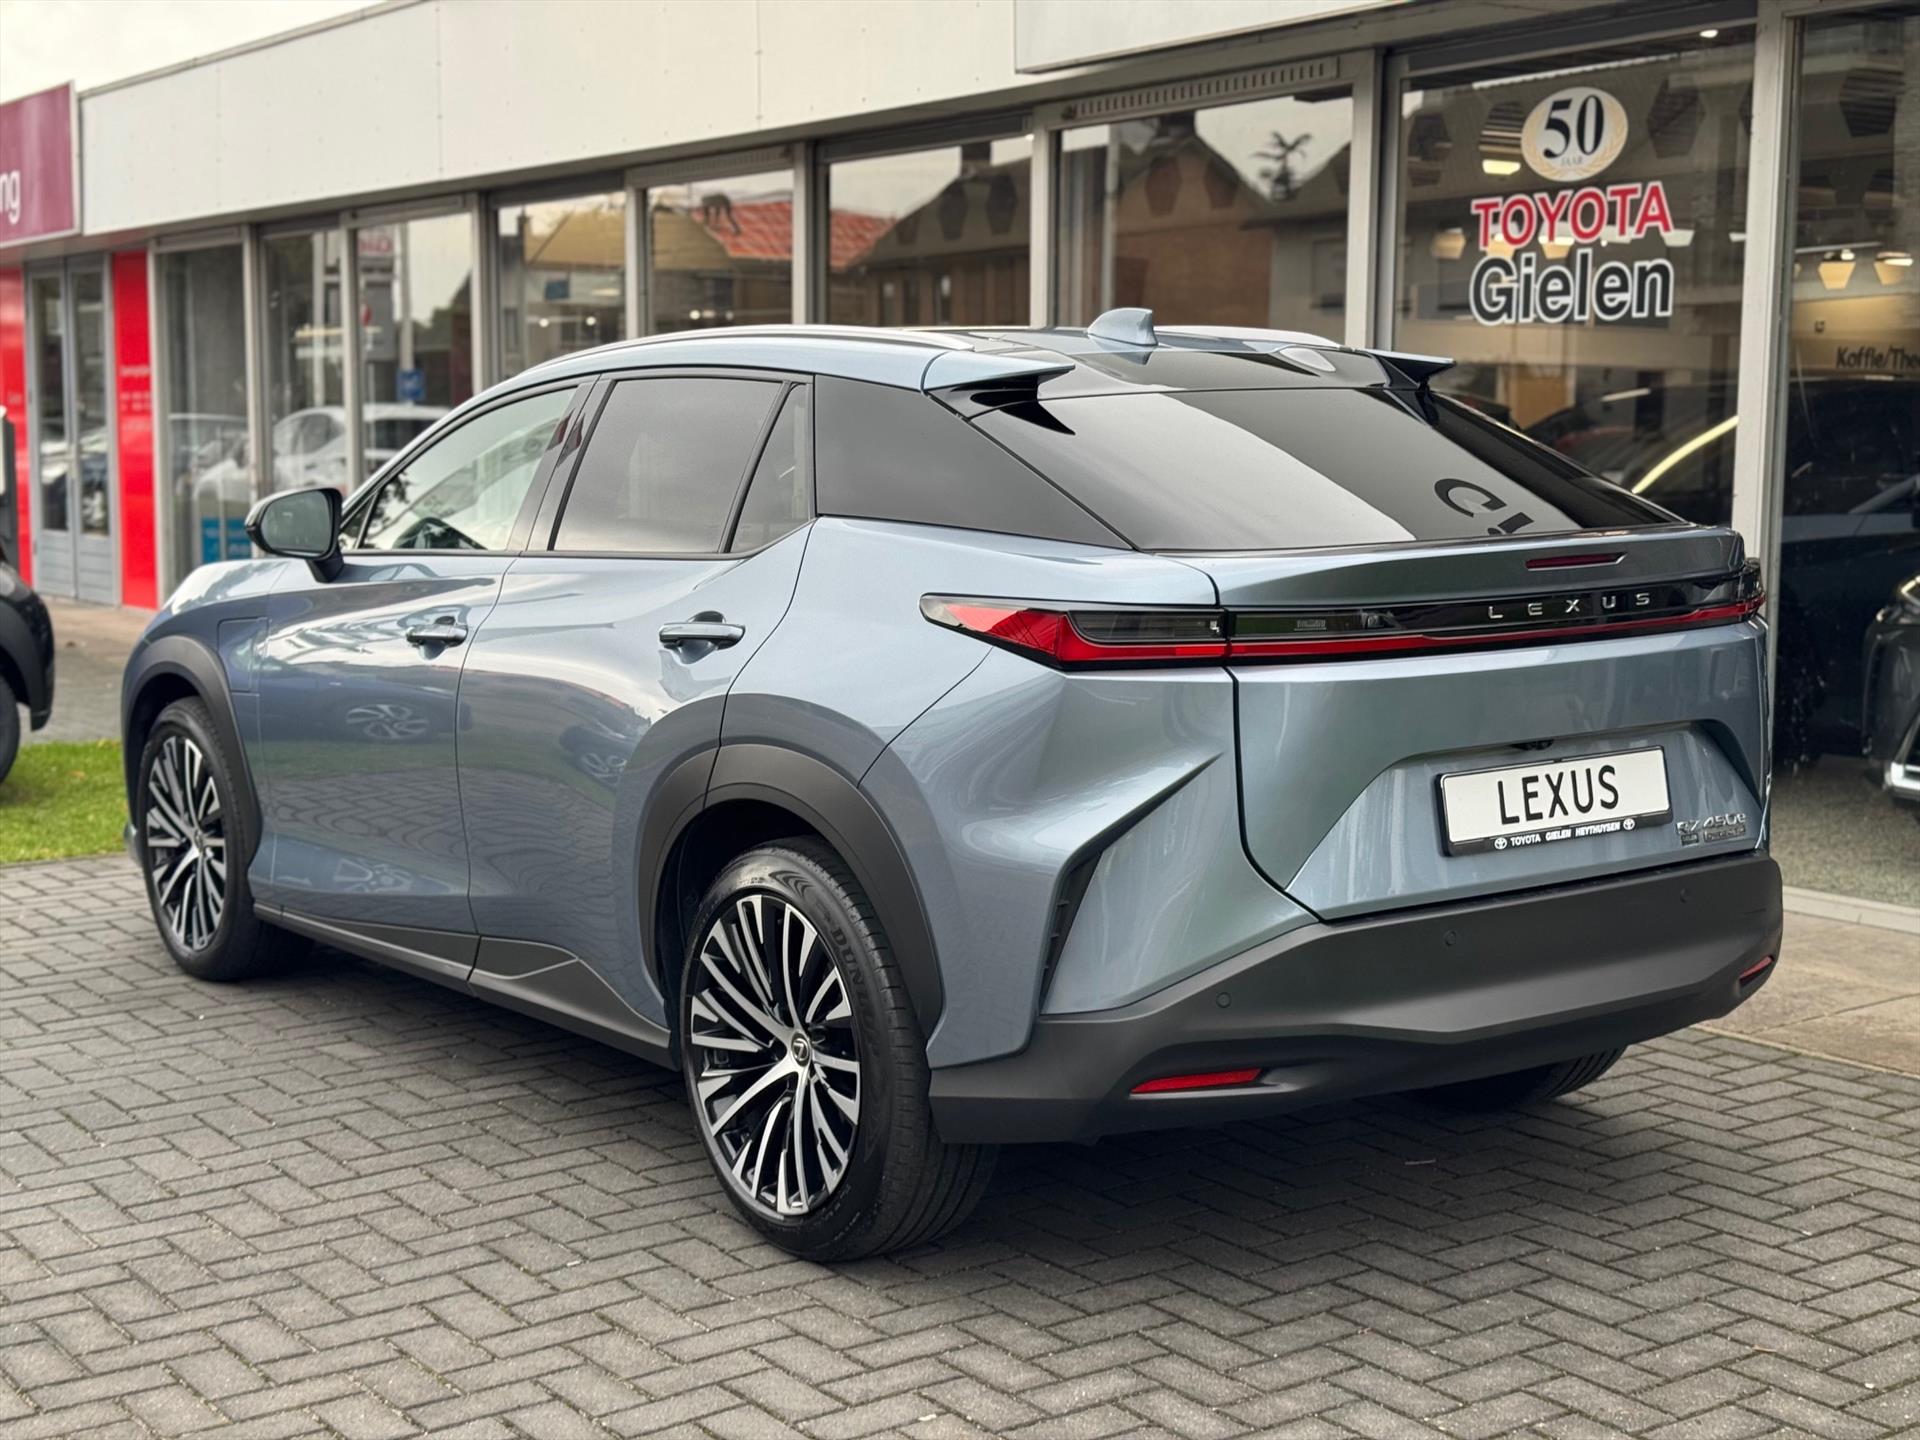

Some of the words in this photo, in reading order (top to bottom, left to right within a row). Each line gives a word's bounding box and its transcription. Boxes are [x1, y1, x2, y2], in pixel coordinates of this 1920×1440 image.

[1543, 95, 1604, 158] 50
[1472, 181, 1673, 250] TOYOTA
[1470, 248, 1674, 326] Gielen
[1488, 593, 1650, 619] LEXUS
[1498, 765, 1619, 825] LEXUS
[1510, 833, 1541, 847] TOYOTA
[1545, 829, 1572, 841] GIELEN
[1575, 821, 1621, 837] HEYTHUYSEN
